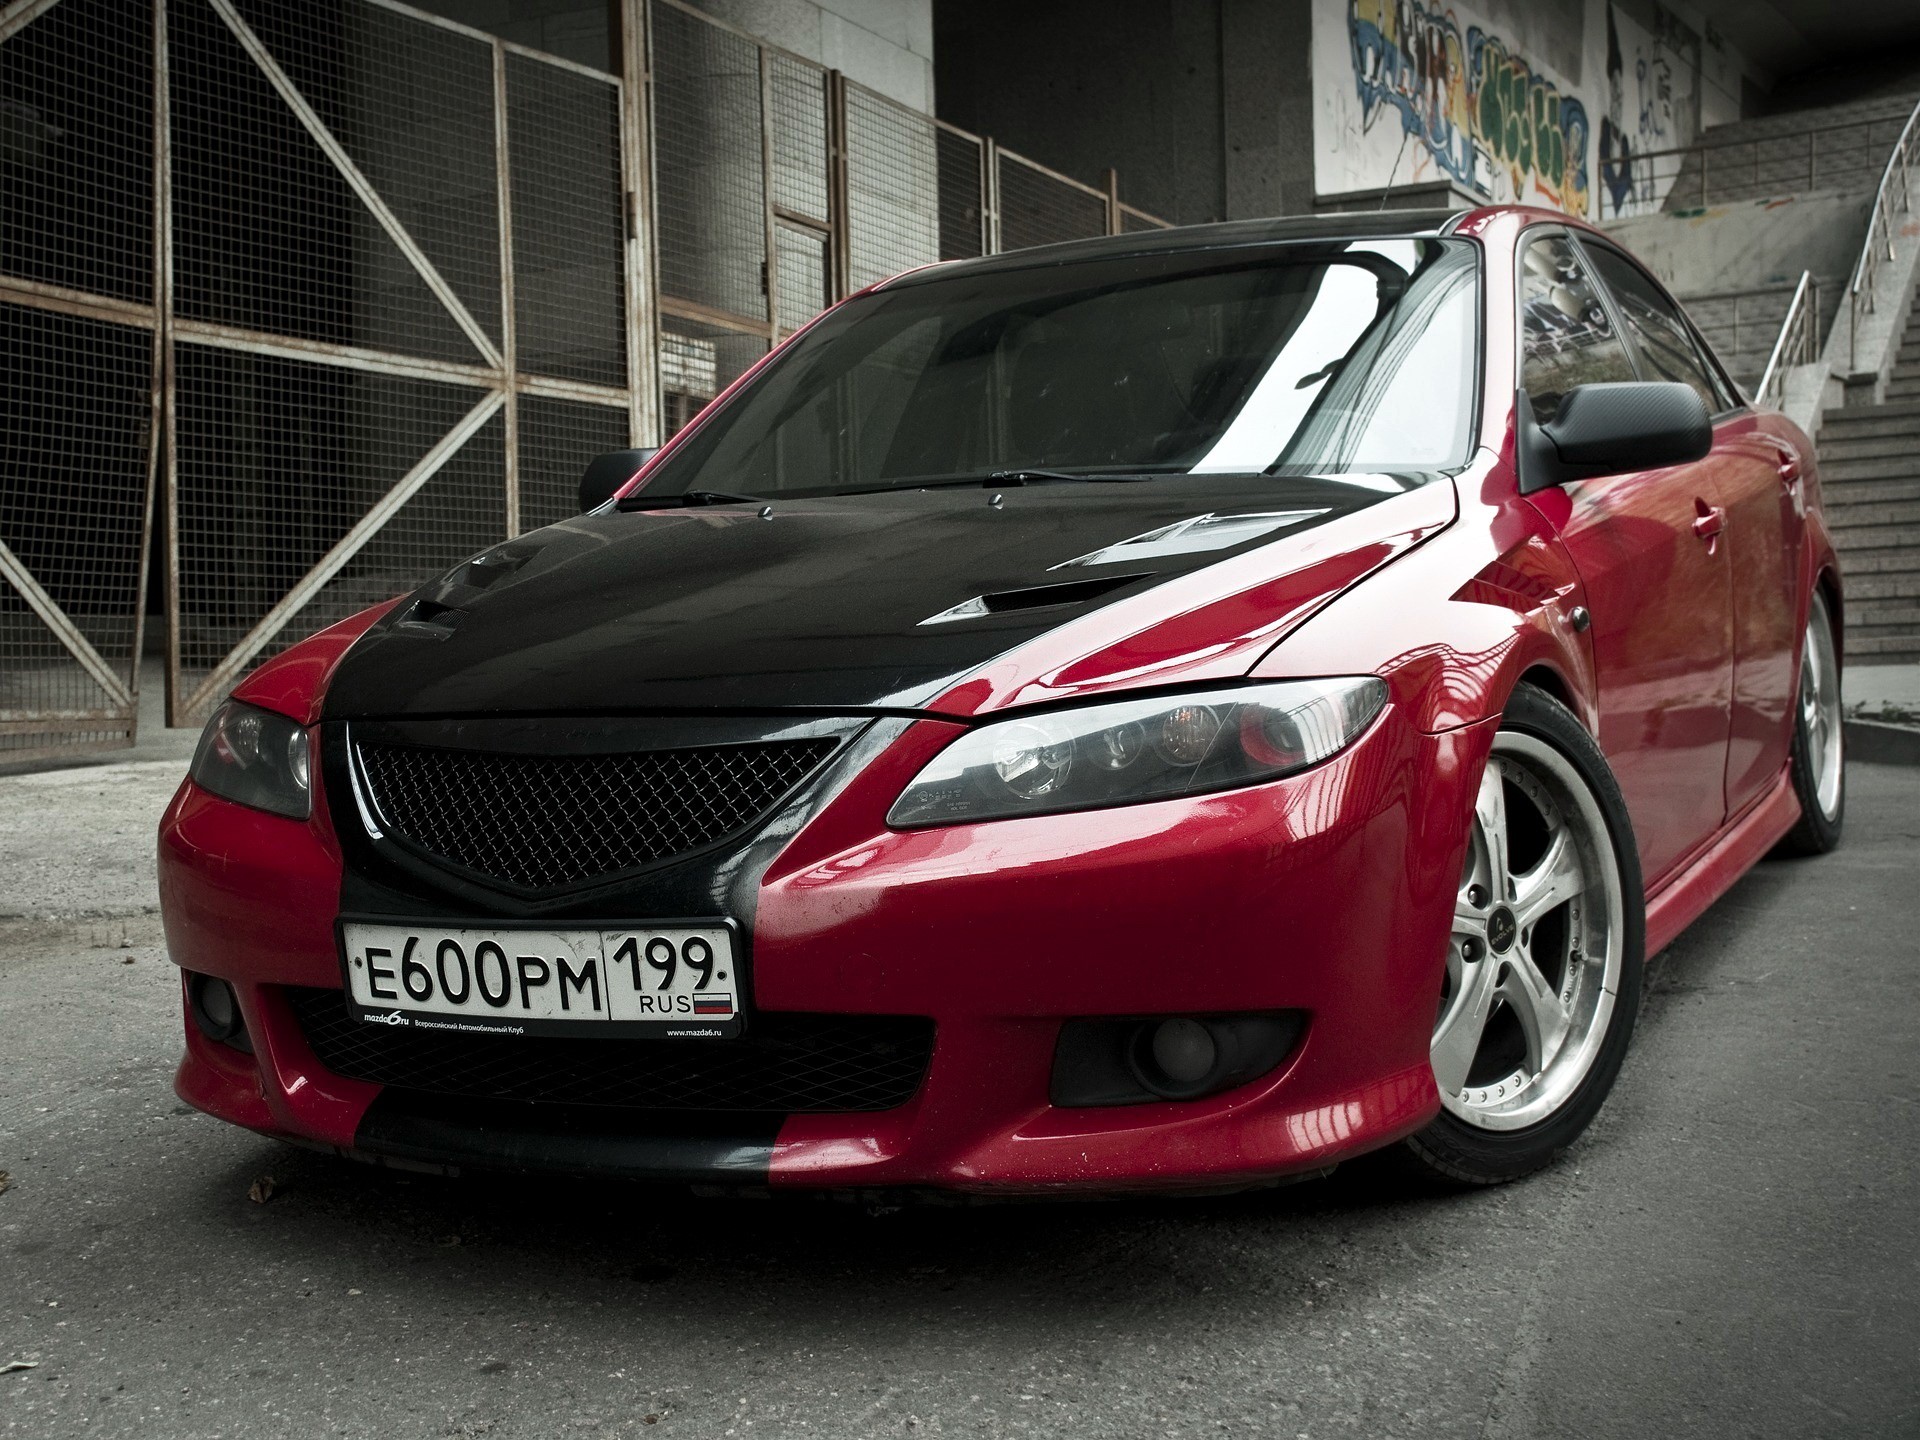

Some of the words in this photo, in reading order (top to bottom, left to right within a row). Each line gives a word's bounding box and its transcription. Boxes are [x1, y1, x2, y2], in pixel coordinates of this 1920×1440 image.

[1491, 923, 1514, 946] EVOLVE
[613, 936, 714, 991] 199
[639, 995, 691, 1014] RUS
[415, 1019, 458, 1030] Всероссийский
[458, 1022, 507, 1033] Автомобильный
[508, 1026, 524, 1035] Клуб
[666, 1029, 722, 1037] www.mazda6.ru
